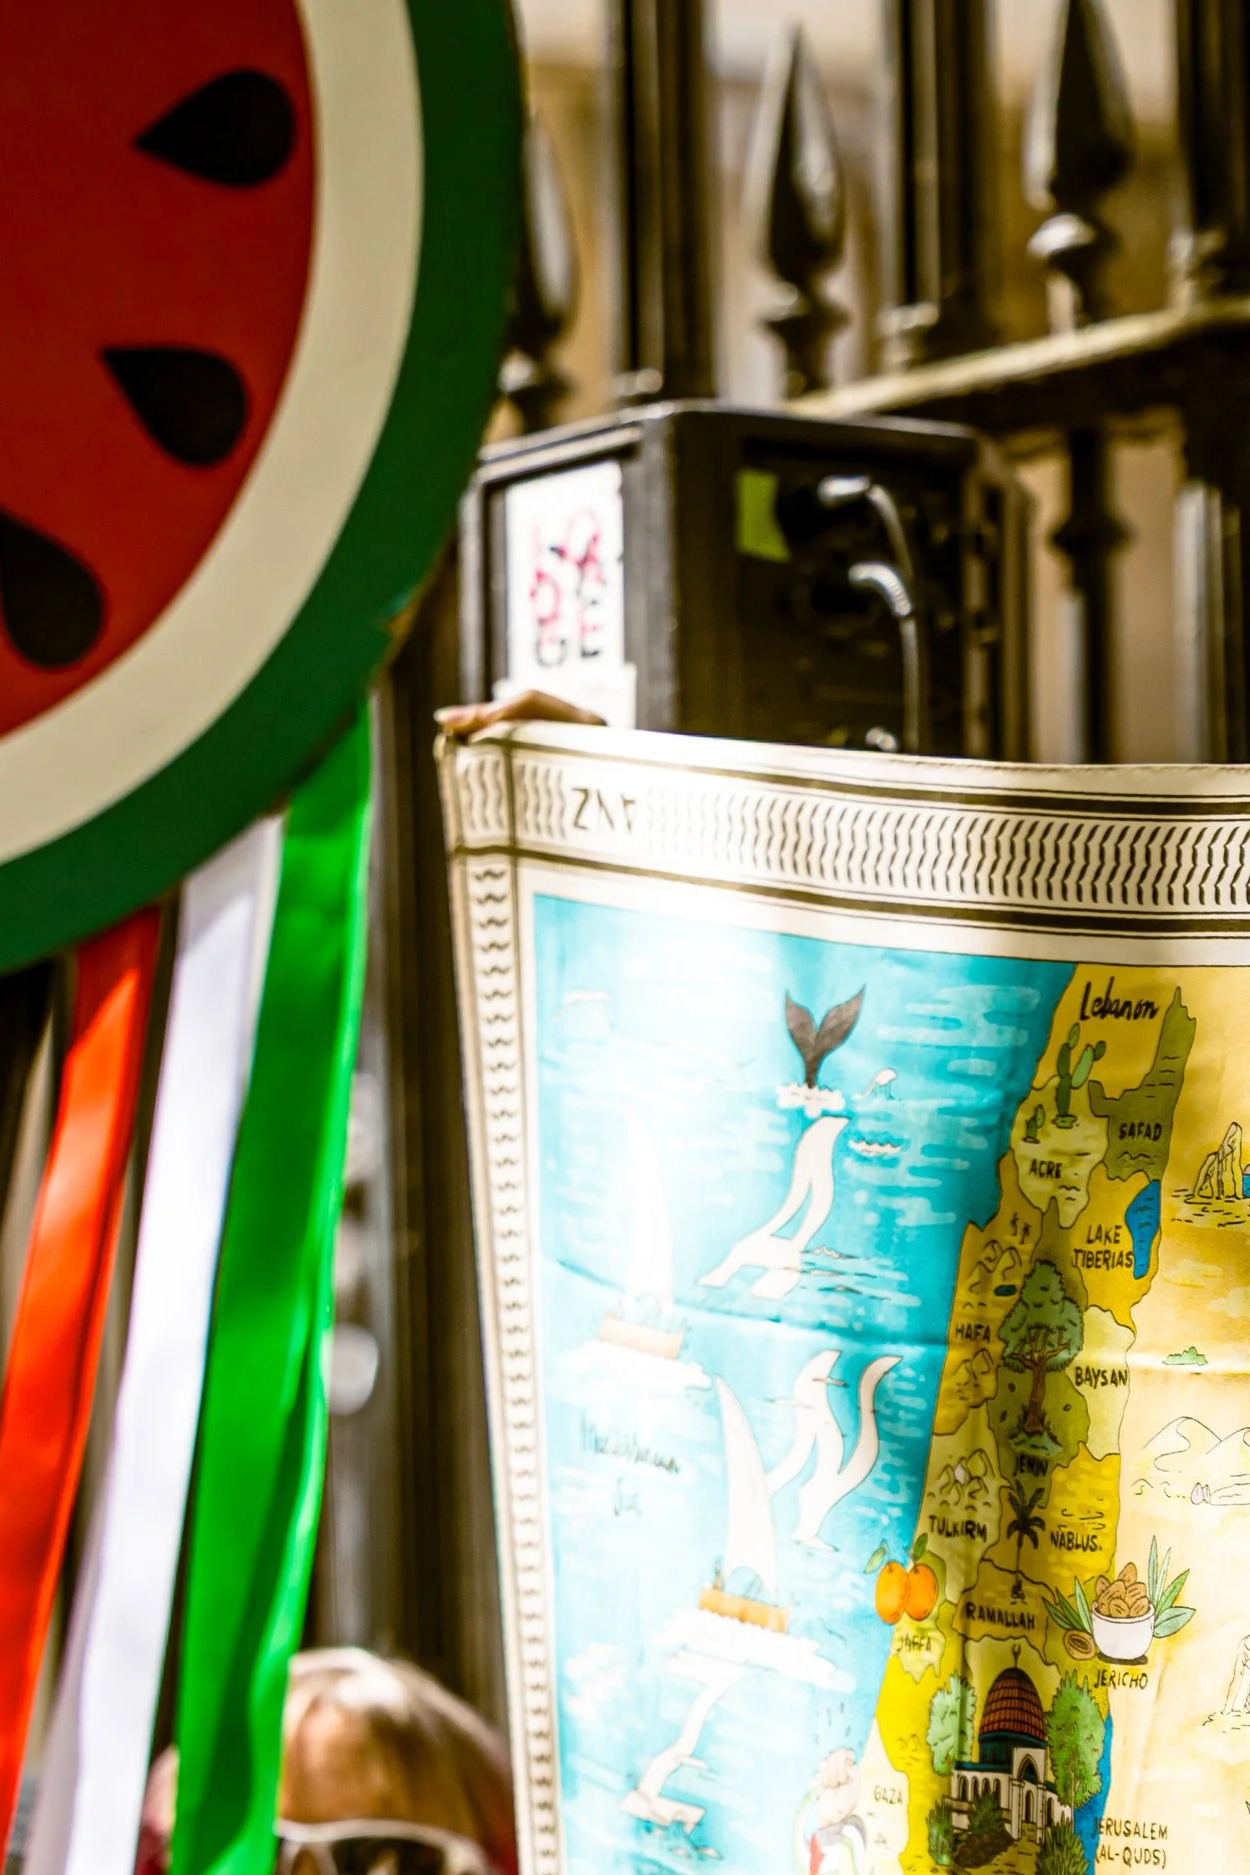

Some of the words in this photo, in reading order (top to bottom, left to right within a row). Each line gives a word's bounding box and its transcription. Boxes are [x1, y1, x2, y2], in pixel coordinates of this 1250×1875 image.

[1080, 977, 1160, 1021] Lebanon
[1118, 1121, 1163, 1141] SAFAD
[1029, 1159, 1062, 1180] ACRE
[1086, 1225, 1122, 1246] LAKE
[1073, 1248, 1134, 1269] TIBERIAS
[1075, 1366, 1128, 1388] BAYSAN
[965, 1601, 1036, 1630] RAMALLAH
[1094, 1670, 1149, 1690] JERICHO
[874, 1784, 903, 1805] GAZA
[1091, 1817, 1168, 1840] JERUSALEM
[1095, 1844, 1167, 1869] (AL-QUDS)
